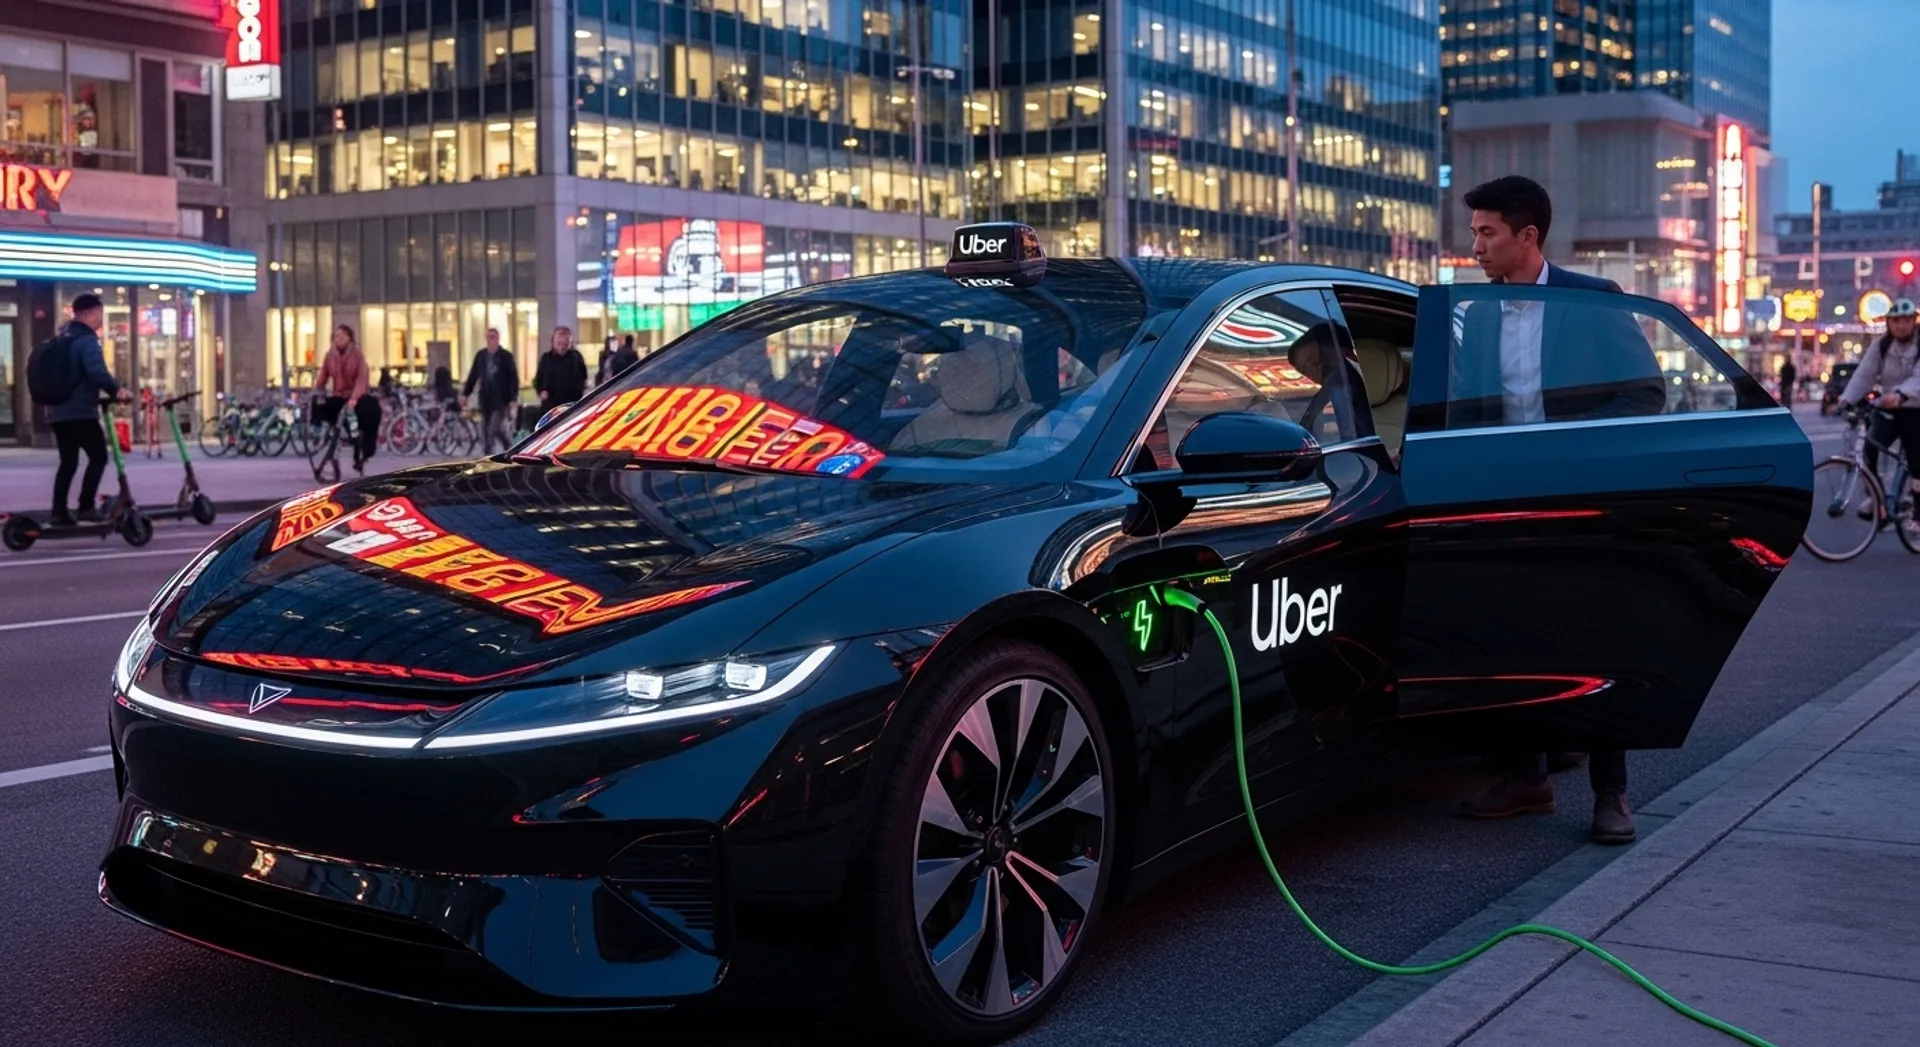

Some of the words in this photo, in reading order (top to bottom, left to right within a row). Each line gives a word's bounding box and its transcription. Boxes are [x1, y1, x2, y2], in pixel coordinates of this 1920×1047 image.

[0, 164, 72, 210] RY
[960, 234, 1007, 254] Uber
[1251, 577, 1342, 651] Uber
